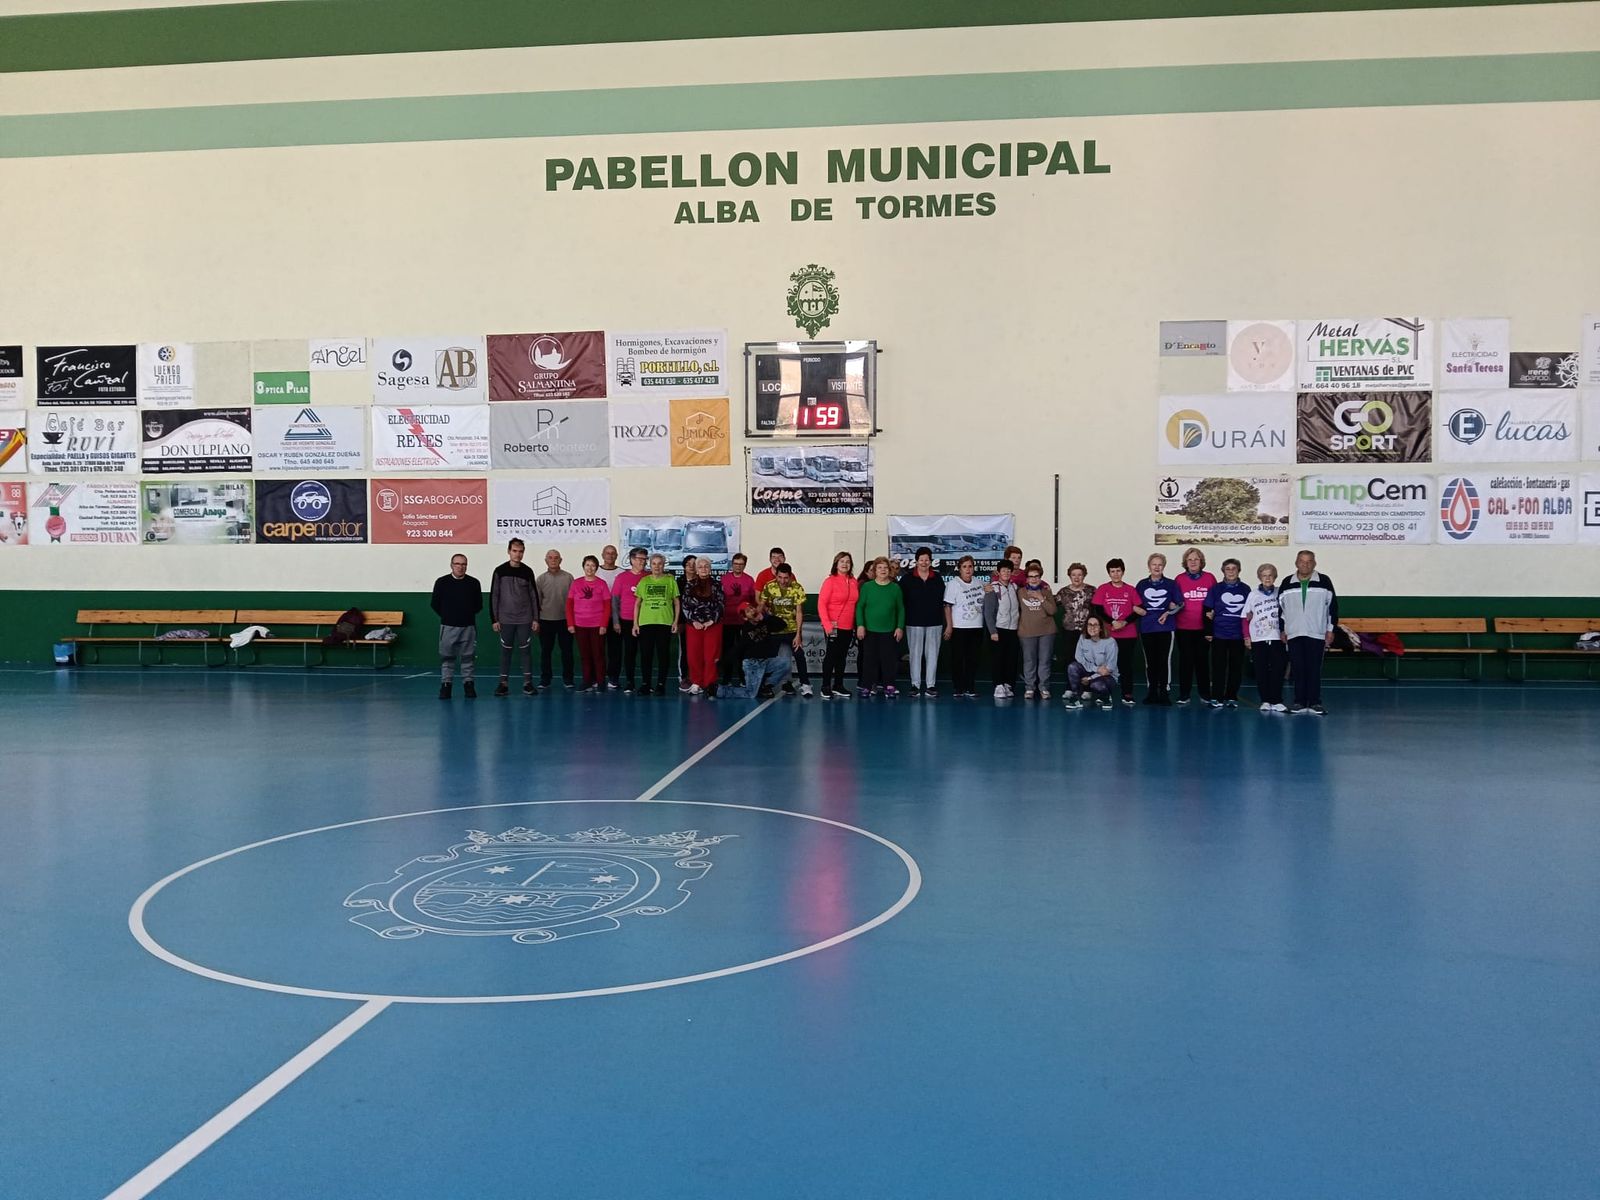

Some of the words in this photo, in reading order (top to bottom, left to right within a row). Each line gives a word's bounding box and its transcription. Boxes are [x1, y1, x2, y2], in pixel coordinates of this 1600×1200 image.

[545, 151, 798, 191] PABELLON
[828, 140, 1111, 184] MUNICIPAL
[674, 200, 760, 224] ALBA
[791, 198, 832, 221] DE
[856, 192, 996, 219] TORMES
[1307, 322, 1359, 341] Metal
[616, 339, 662, 347] Hormigones,
[665, 337, 712, 345] Excavaciones
[1320, 334, 1409, 356] HERVÁS
[671, 347, 706, 355] hormigón
[45, 349, 110, 376] Francisco
[437, 350, 476, 387] AB
[1446, 363, 1472, 373] Santa
[1475, 362, 1503, 372] Teresa
[154, 365, 180, 374] LUENGO
[1334, 365, 1379, 376] VENTANAS
[1383, 365, 1394, 375] de
[1398, 365, 1414, 375] PVC
[154, 375, 180, 384] PRIETO
[378, 372, 429, 390] Sagesa
[388, 415, 450, 424] ELECTRICIDAD
[816, 407, 838, 425] 59
[1334, 401, 1393, 434] GO
[48, 416, 84, 436] Café
[94, 419, 125, 431] Bar
[612, 425, 667, 438] TROZZO
[1495, 410, 1571, 441] lucas
[397, 435, 443, 447] REYES
[1330, 435, 1397, 450] SPORT
[161, 445, 189, 456] DON
[193, 444, 250, 455] ULPIANO
[504, 443, 549, 452] Roberto
[1300, 478, 1426, 504] LimpCem
[1561, 479, 1570, 491] gas
[404, 495, 483, 504] SSGABOGADOS
[753, 487, 803, 500] Cosme
[753, 506, 873, 514] www.autocarescosme.com
[1488, 498, 1509, 515] CAL
[1518, 497, 1539, 514] FON
[1543, 497, 1572, 515] ALBA
[203, 508, 226, 517] Anaya
[497, 519, 564, 527] ESTRUCTURAS
[566, 518, 607, 526] TORMES
[1356, 523, 1373, 531] 923
[1376, 523, 1389, 531] 08
[1392, 523, 1405, 531] 08
[263, 519, 363, 540] carpemotor
[100, 533, 137, 542] DURAN
